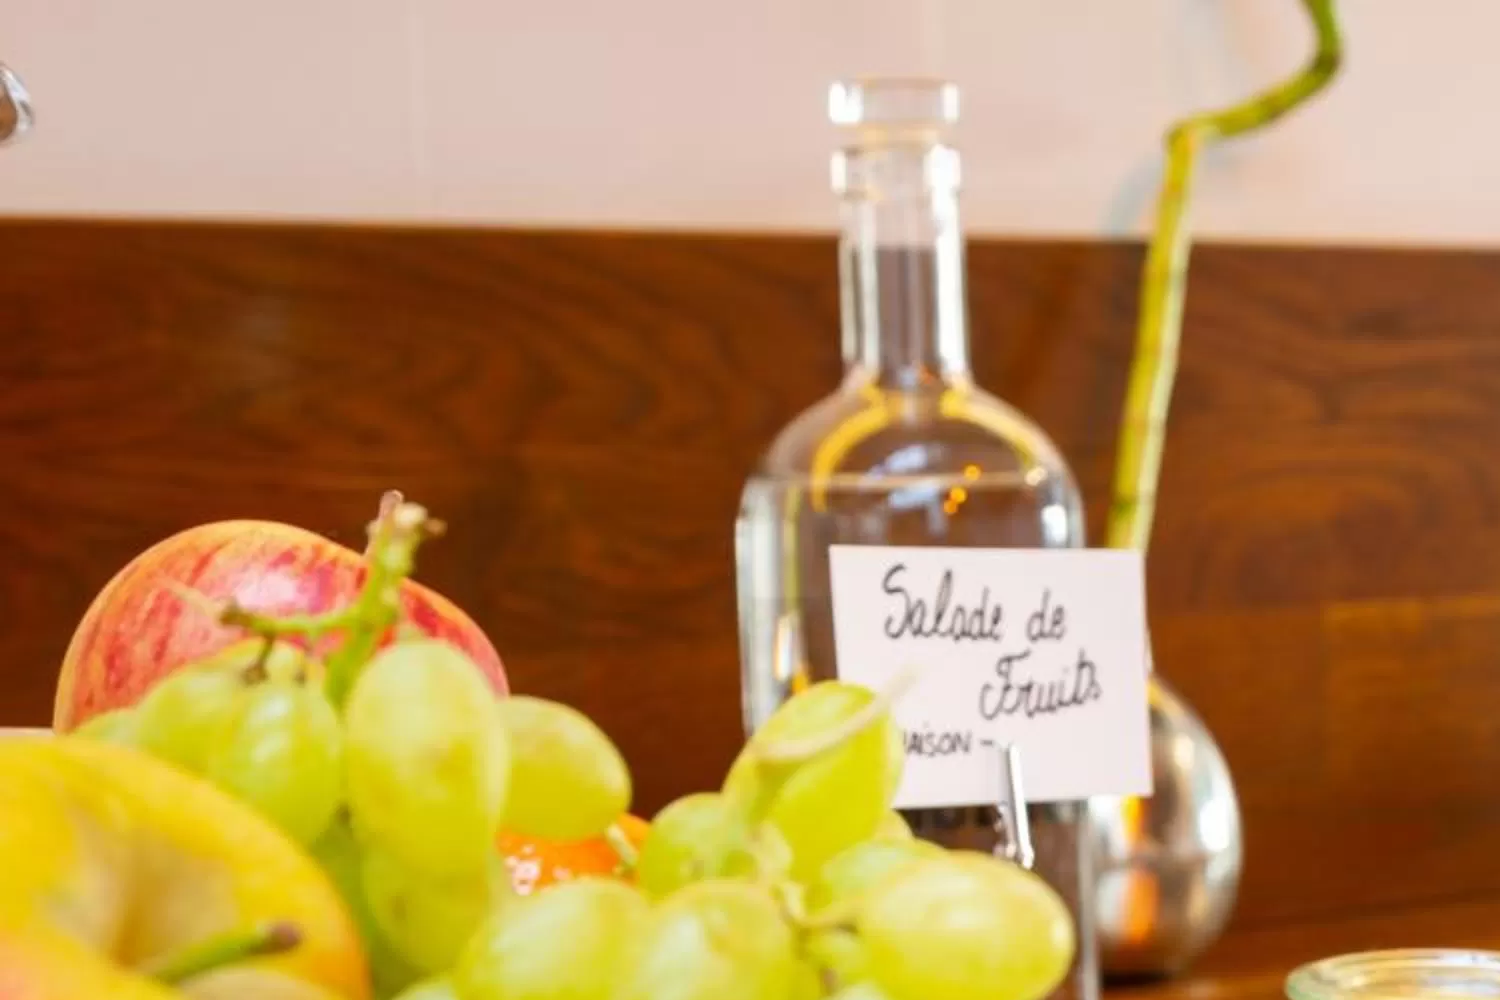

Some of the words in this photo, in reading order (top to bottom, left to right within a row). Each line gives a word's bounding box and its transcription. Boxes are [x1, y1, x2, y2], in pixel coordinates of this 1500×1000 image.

[882, 564, 1004, 641] Salade
[1026, 588, 1066, 642] de
[979, 649, 1102, 720] Fruits
